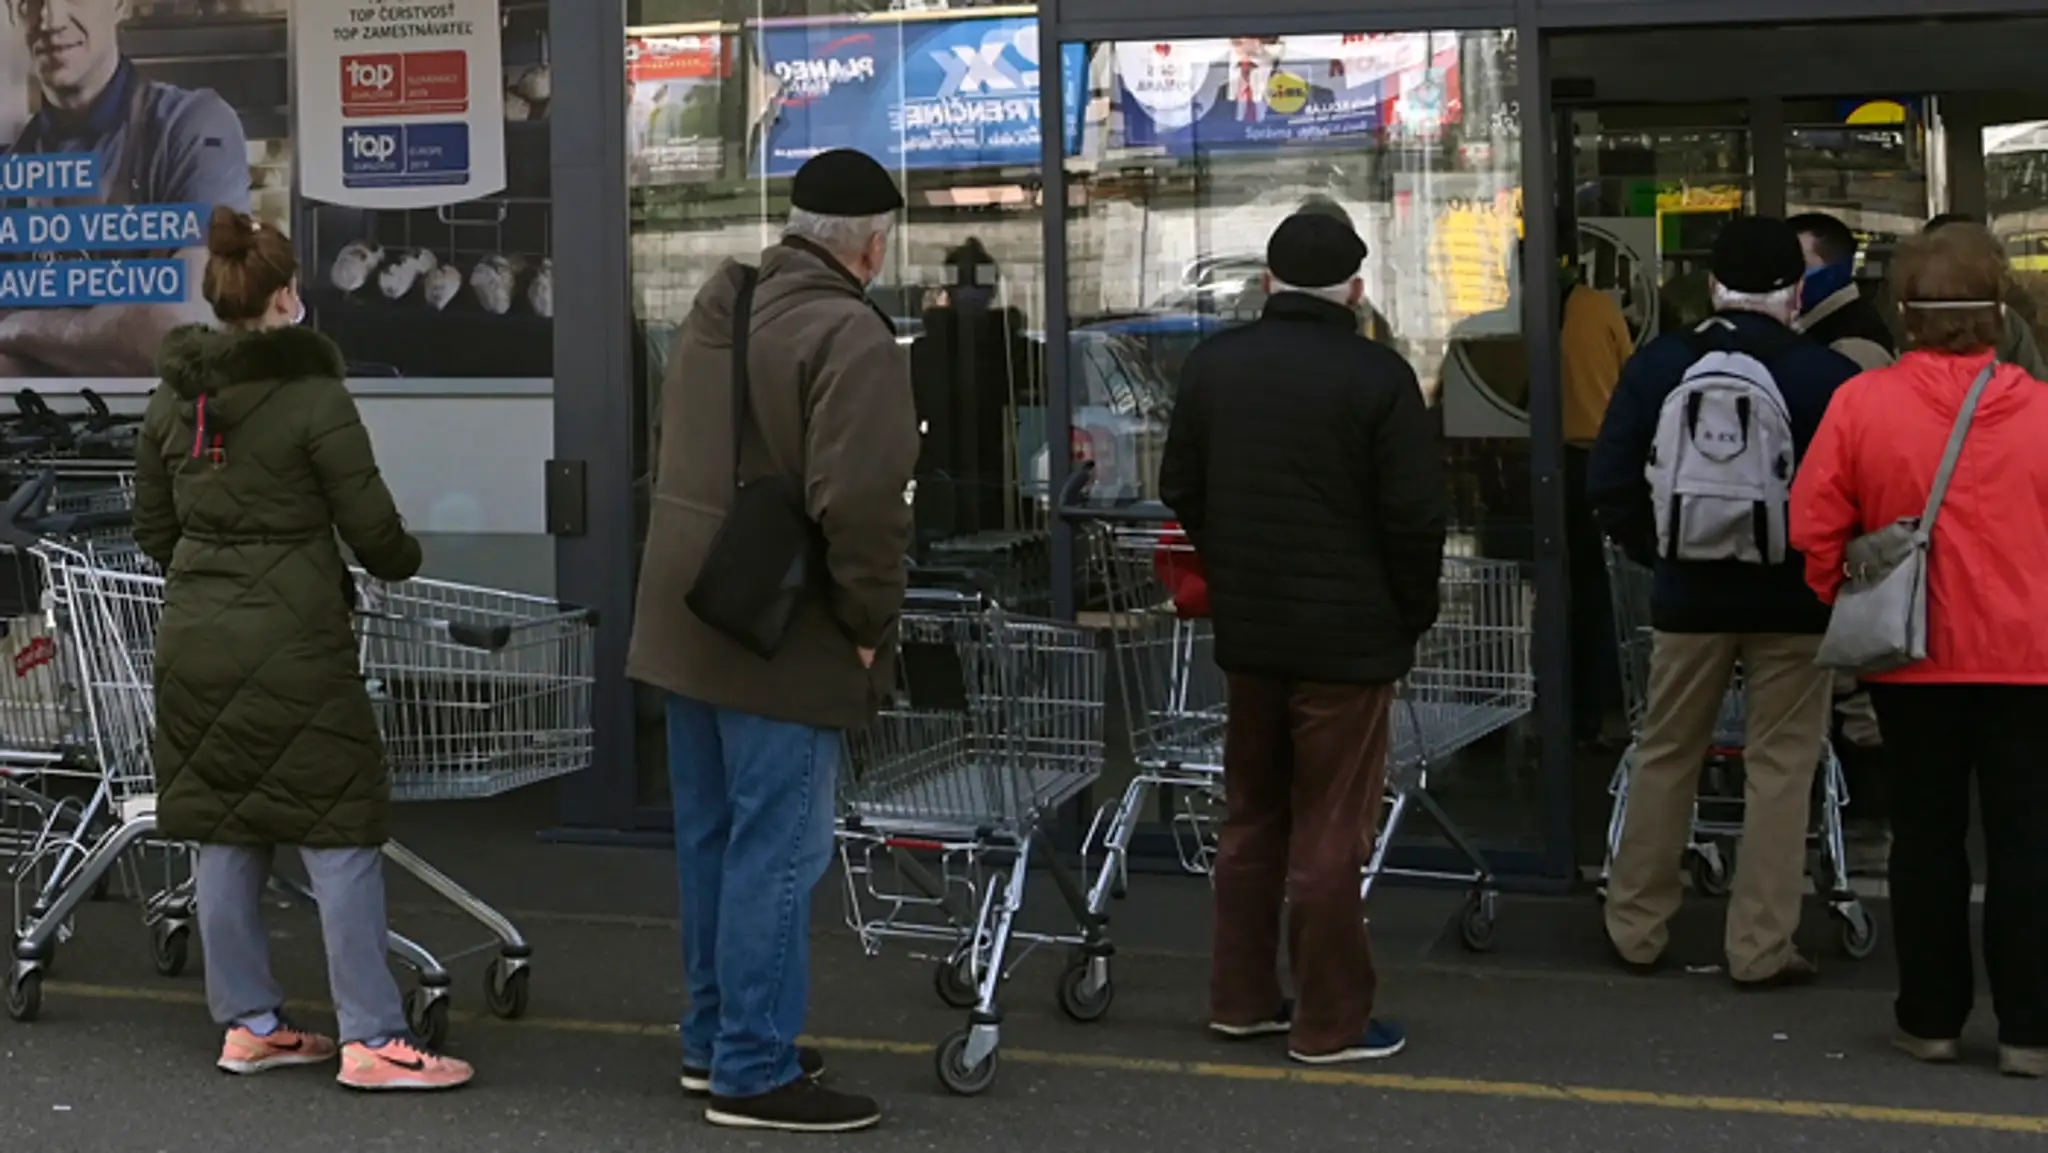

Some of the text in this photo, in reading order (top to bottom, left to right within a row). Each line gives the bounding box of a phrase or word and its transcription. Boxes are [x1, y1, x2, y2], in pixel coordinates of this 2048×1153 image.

[349, 8, 375, 22] TOP
[333, 27, 359, 41] TOP
[346, 60, 394, 89] top
[348, 130, 396, 161] top
[0, 154, 93, 191] ÚPITE
[29, 213, 71, 244] DO
[80, 204, 201, 242] VEČERA
[0, 258, 179, 298] AVÉ PEČIVO
